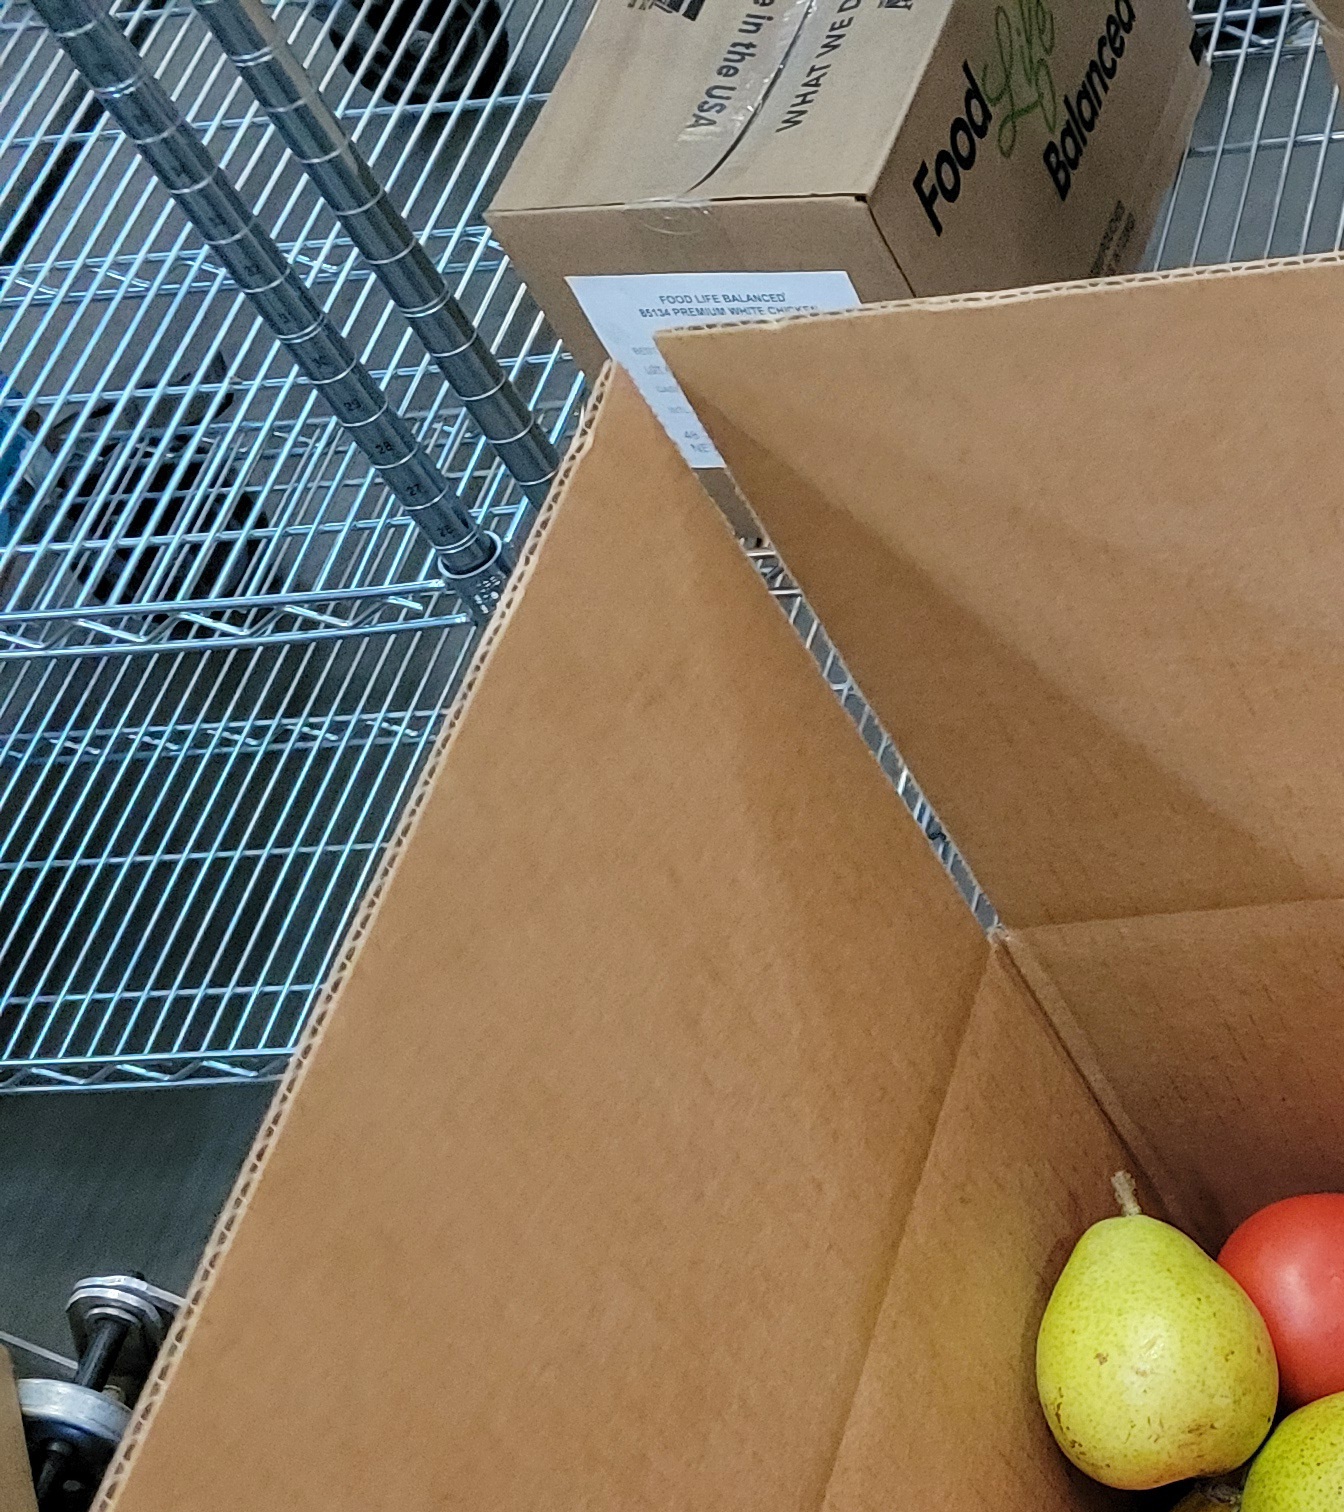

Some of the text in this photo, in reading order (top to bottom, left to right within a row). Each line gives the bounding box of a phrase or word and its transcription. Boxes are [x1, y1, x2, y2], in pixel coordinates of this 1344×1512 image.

[716, 43, 757, 79] the
[775, 63, 831, 133] WHAT
[816, 16, 854, 58] WE
[685, 84, 737, 129] USA
[1043, 0, 1136, 201] Balanced
[912, 59, 993, 237] Food
[658, 292, 785, 305] FOOD LIFE BALANCED
[672, 307, 725, 317] PREMIUM
[729, 306, 765, 316] WHITE
